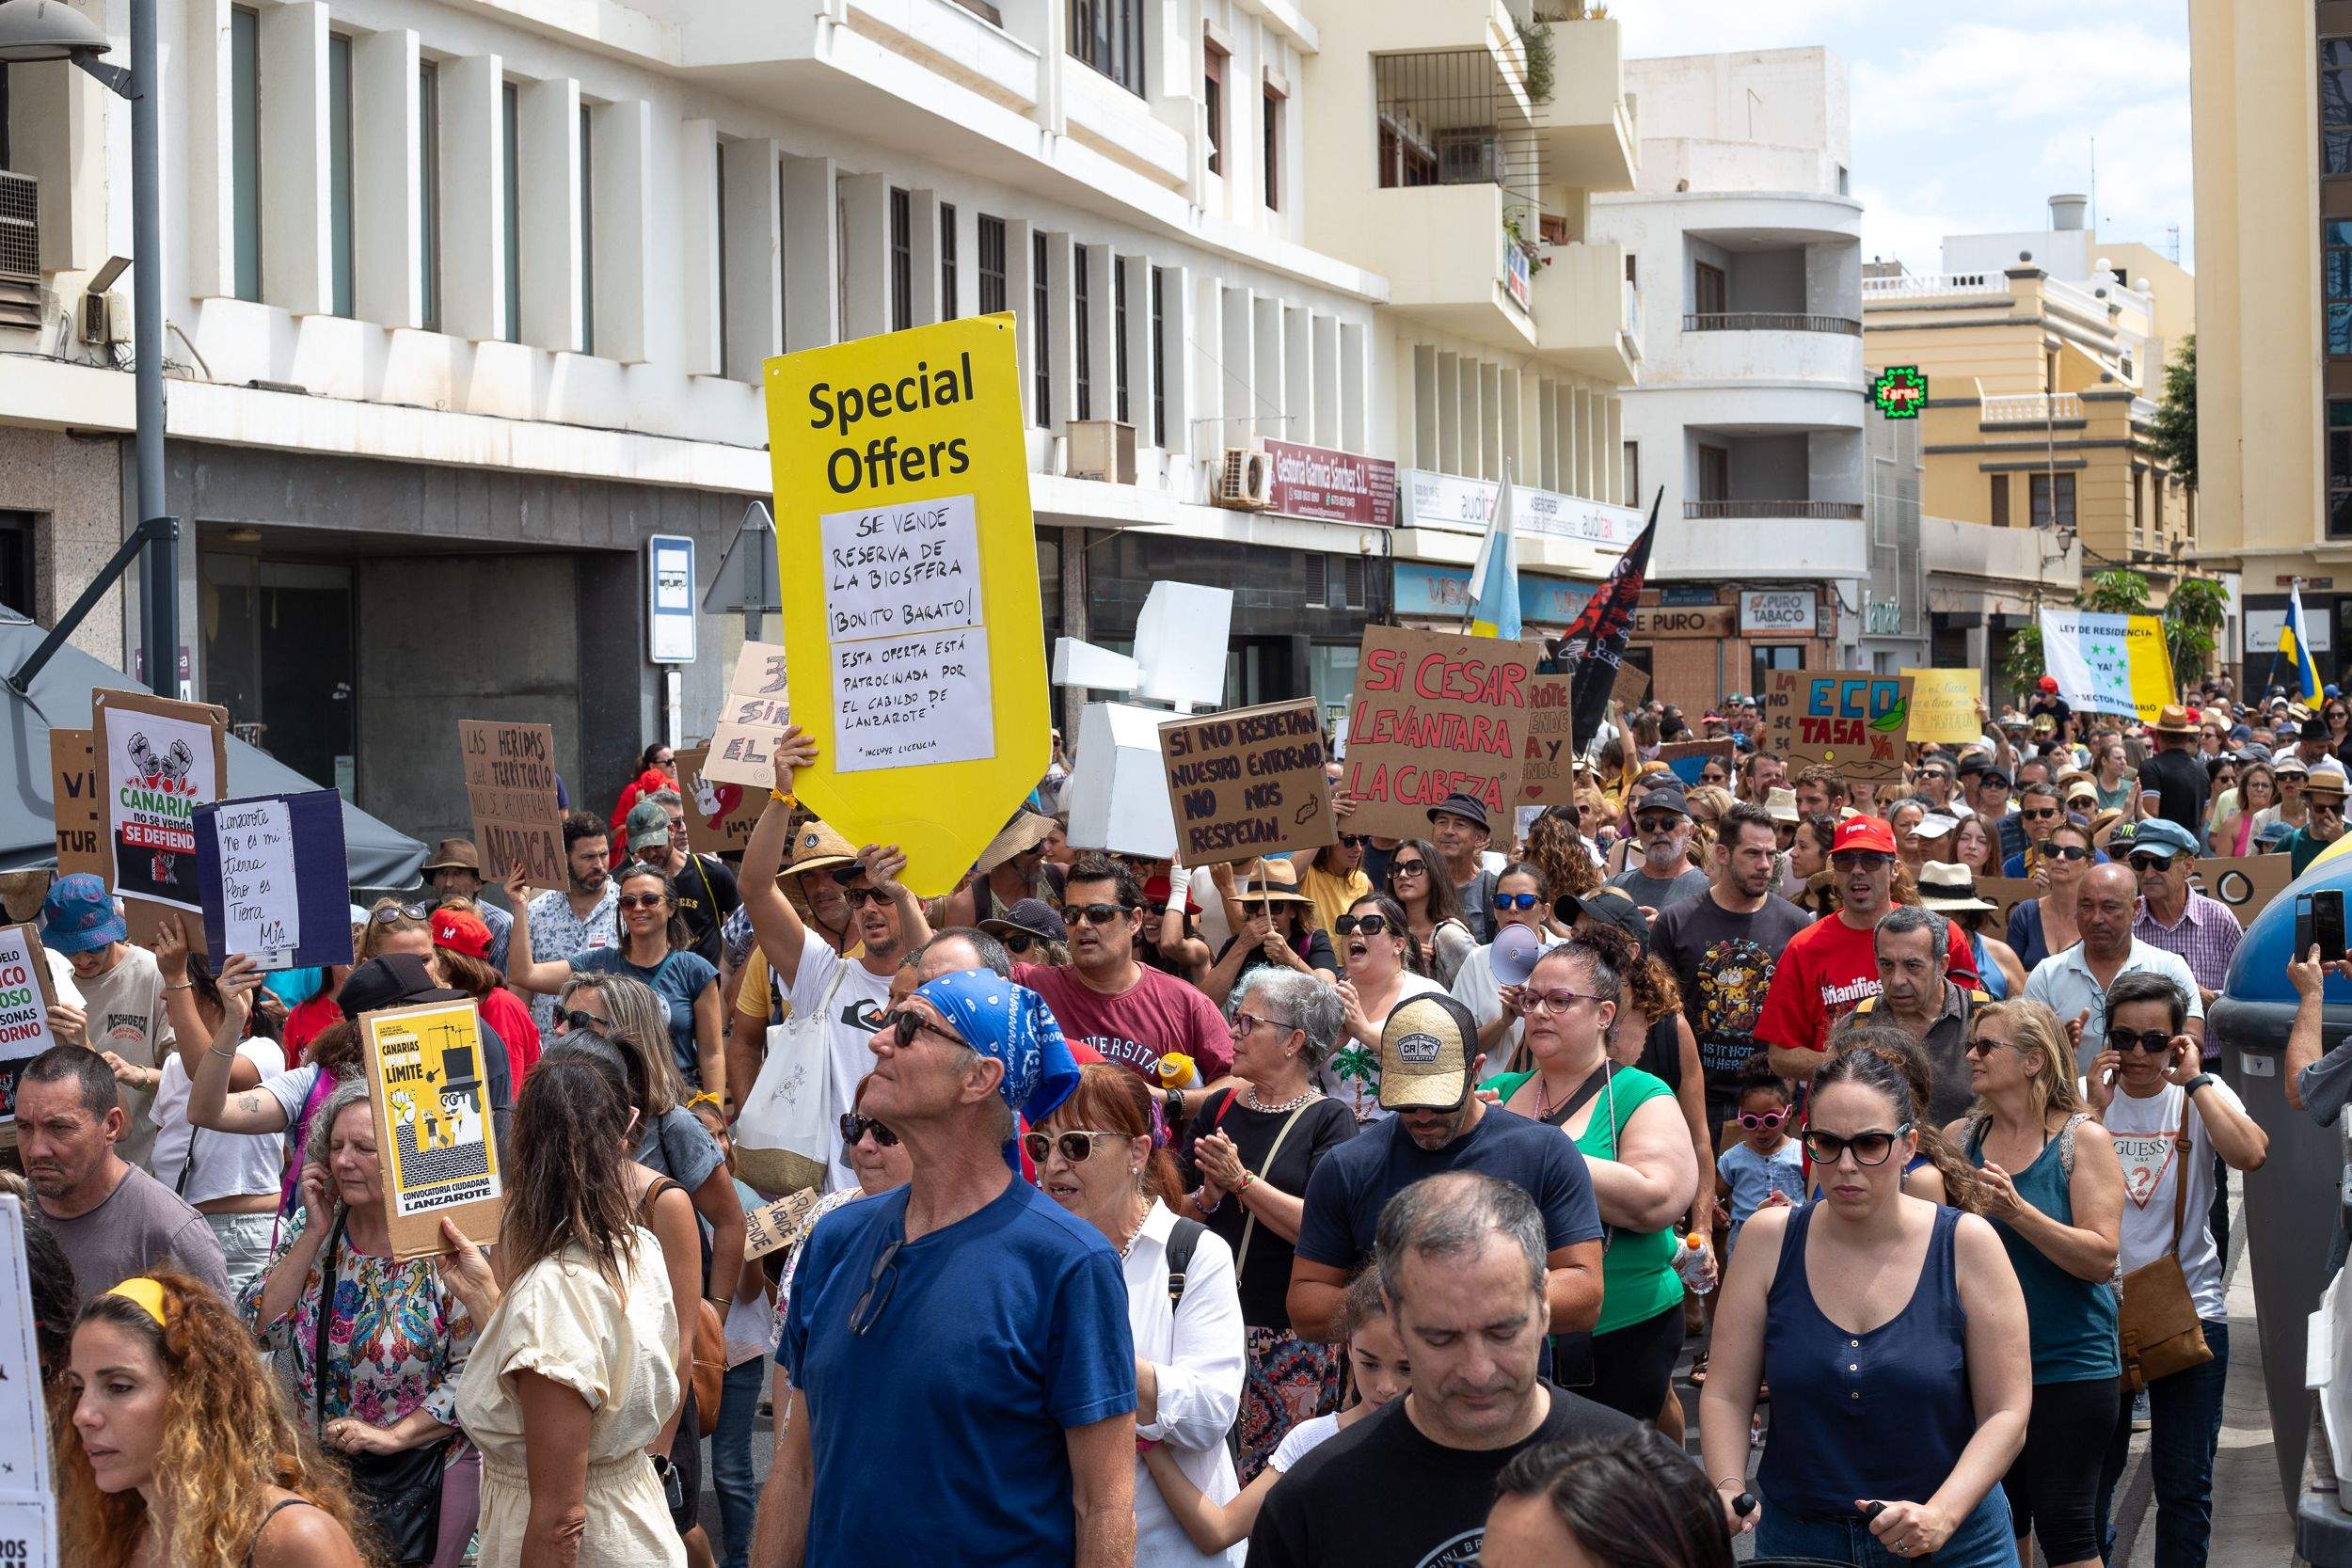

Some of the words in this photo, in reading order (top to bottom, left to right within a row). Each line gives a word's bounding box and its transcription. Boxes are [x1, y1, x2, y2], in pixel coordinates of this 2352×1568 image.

[809, 352, 973, 436] Special
[827, 436, 970, 494] Offers
[856, 515, 885, 537] SE
[893, 507, 949, 533] VENDE
[833, 545, 908, 568] RESERVA
[921, 540, 946, 559] DE
[834, 574, 858, 591] LA
[868, 560, 961, 589] BIOSFERA
[829, 603, 893, 636] ¡BONITO
[902, 588, 972, 625] BARATO!
[1653, 613, 1705, 631] PURO
[1754, 610, 1804, 623] TABACO
[2059, 625, 2076, 633] LEY
[2078, 626, 2090, 635] DE
[2093, 626, 2152, 637] RESIDENCIA
[842, 652, 872, 669] ESTA
[882, 644, 927, 662] OFERTA
[935, 634, 965, 655] ESTÁ
[843, 669, 929, 692] PATROCINADA
[942, 664, 966, 678] POR
[1414, 647, 1527, 708] CÉSAR
[2097, 662, 2112, 672] YA!
[842, 701, 858, 714] EL
[868, 693, 918, 710] CABILDO
[929, 689, 948, 703] DE
[1769, 693, 1788, 706] NO
[1808, 678, 1900, 720] ECO
[2081, 694, 2115, 704] SECTOR
[2117, 698, 2156, 712] PRIMARIO
[1198, 722, 1233, 752] NO
[1236, 709, 1317, 746] RESPETAN
[1351, 700, 1513, 758] LEVANTARA
[1529, 709, 1568, 734] ENDE
[1799, 718, 1866, 746] TASA
[467, 730, 486, 755] LAS
[723, 738, 767, 763] EL
[898, 740, 937, 753] LICENCIA
[473, 763, 486, 784] del
[1170, 754, 1242, 788] NUESTRO
[1350, 762, 1389, 802] LA
[1393, 765, 1504, 814] CABEZA
[120, 787, 204, 819] CANARIA
[470, 790, 485, 815] NO
[490, 791, 501, 816] SE
[503, 792, 553, 821] RECUPERAN
[1182, 788, 1216, 821] NO
[1244, 781, 1283, 812] NOS
[134, 812, 146, 823] no
[149, 816, 160, 825] se
[220, 808, 268, 831] Lanzarote
[126, 826, 141, 842] SE
[144, 829, 196, 850] DEFIEND
[224, 835, 239, 851] no
[247, 834, 258, 848] es
[263, 829, 279, 845] mi
[1187, 816, 1287, 855] RESPETAN.
[485, 825, 562, 881] NUNCA
[223, 857, 266, 876] tierra
[224, 878, 250, 900] Pero
[260, 880, 271, 894] es
[230, 902, 265, 922] Tierra
[0, 988, 32, 1008] OSO
[1820, 976, 1884, 1006] Manifies
[382, 1040, 419, 1055] CANARIAS
[1080, 1035, 1160, 1075] VERSITA
[1404, 1044, 1416, 1053] CR
[1703, 1043, 1714, 1054] IS
[1728, 1044, 1755, 1057] HOT
[386, 1060, 423, 1084] LÍMITE
[1704, 1055, 1714, 1068] IN
[2113, 1139, 2166, 1157] GUESS
[403, 1185, 451, 1201] CONVOCATORIA
[452, 1178, 489, 1192] CIUDADANA
[405, 1187, 491, 1212] LANZAROTE
